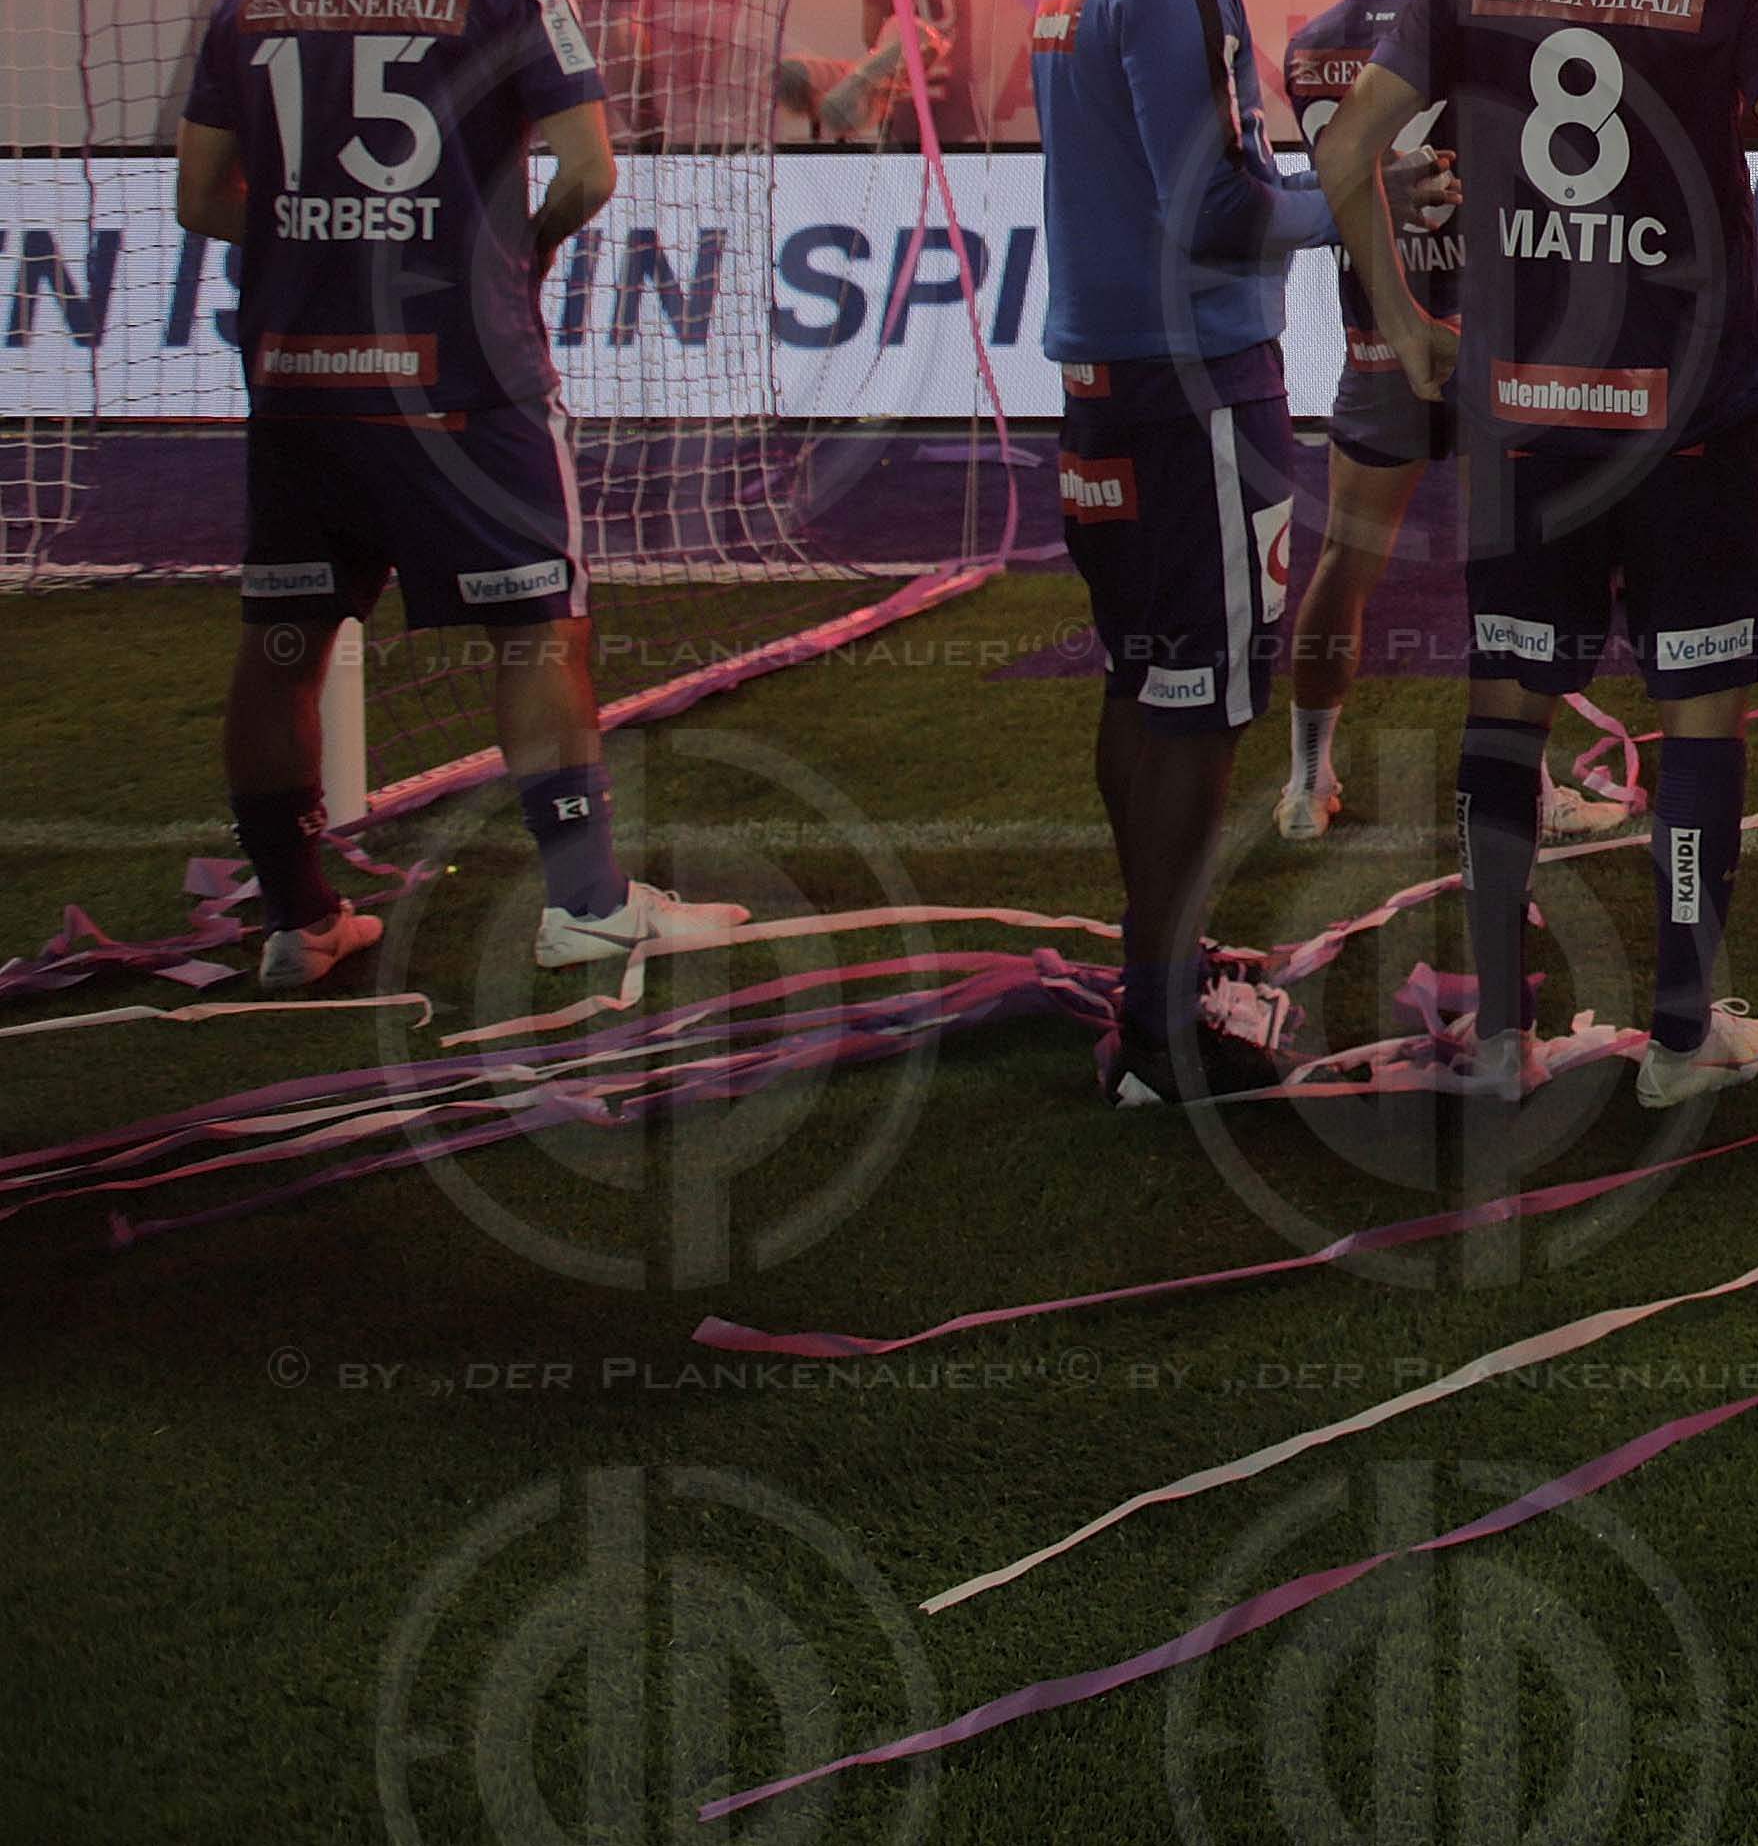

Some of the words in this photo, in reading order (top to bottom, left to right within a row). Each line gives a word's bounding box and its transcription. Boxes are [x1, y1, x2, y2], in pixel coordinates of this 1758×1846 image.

[250, 34, 442, 194] 15
[1521, 27, 1630, 207] 8
[274, 195, 441, 243] SRBEST
[1499, 206, 1668, 266] MATIC
[465, 566, 562, 601] Verbund
[1665, 628, 1750, 663] Verbund
[1677, 833, 1696, 904] KANDL
